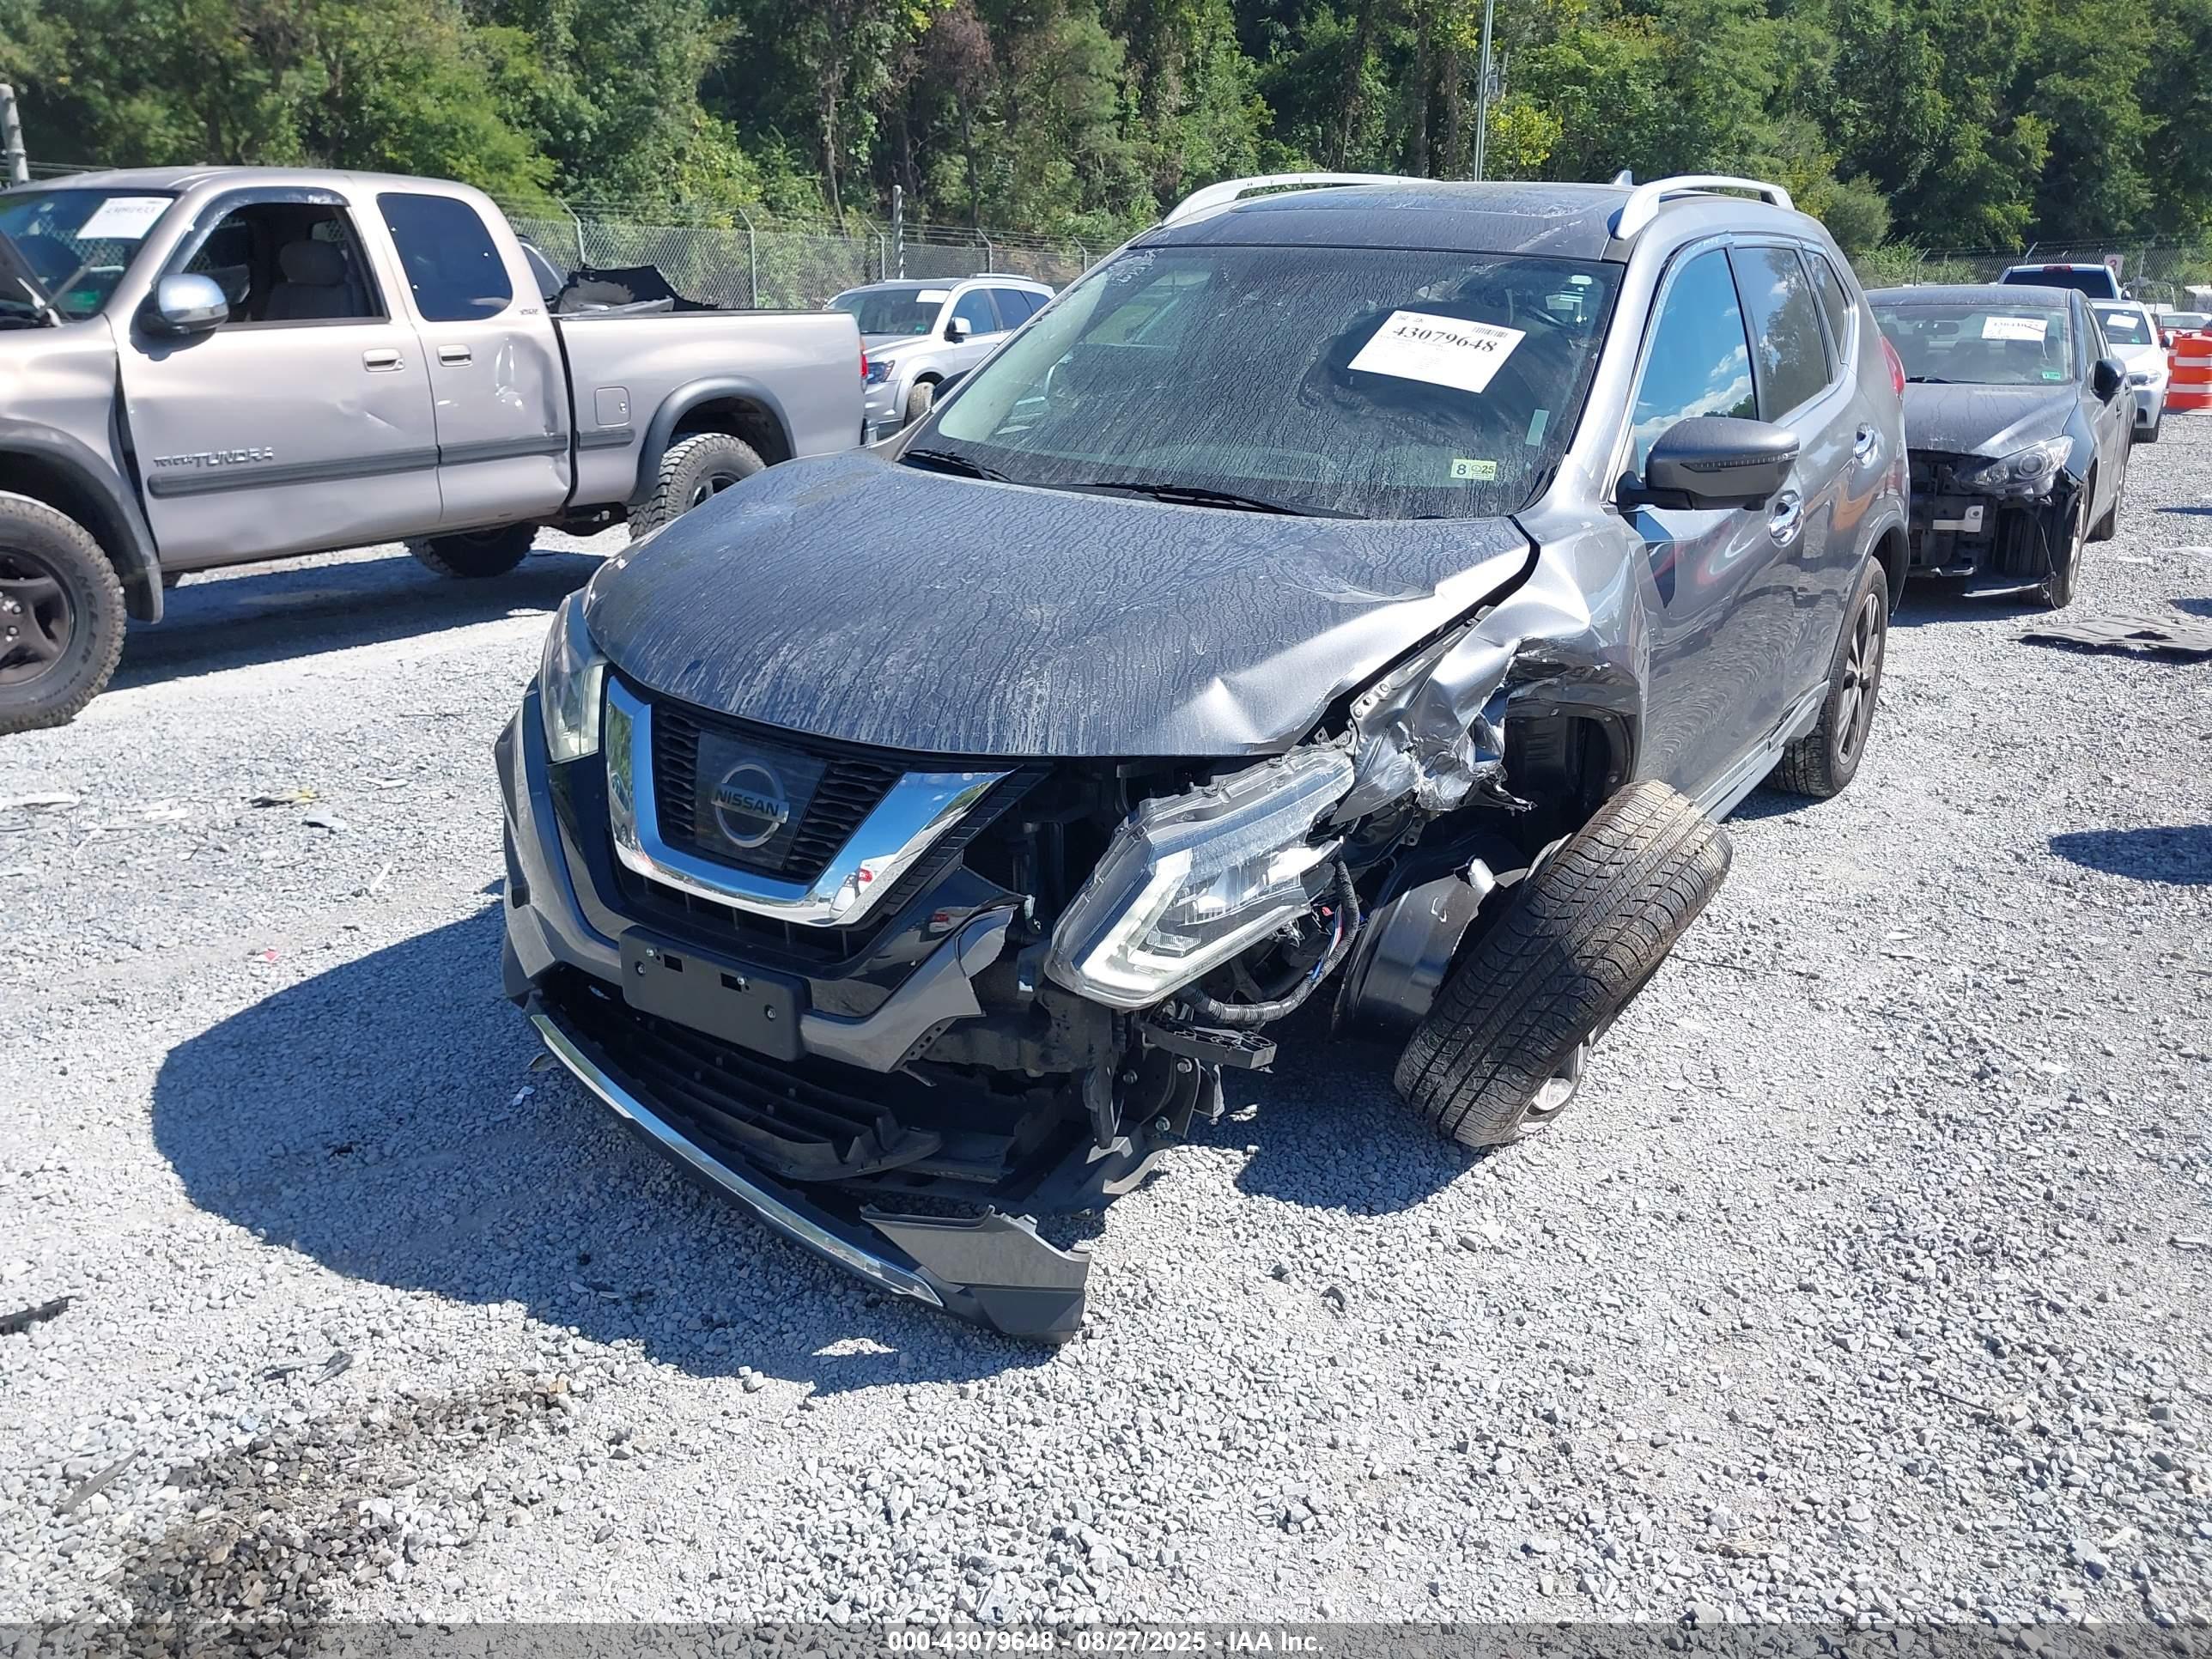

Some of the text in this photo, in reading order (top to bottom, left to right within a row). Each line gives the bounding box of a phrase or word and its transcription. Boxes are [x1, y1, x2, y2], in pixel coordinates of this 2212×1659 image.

[1392, 325, 1498, 353] 43079648
[193, 446, 274, 468] TUNDRA
[1455, 464, 1495, 475] 8 25
[714, 788, 780, 817] NISSAN
